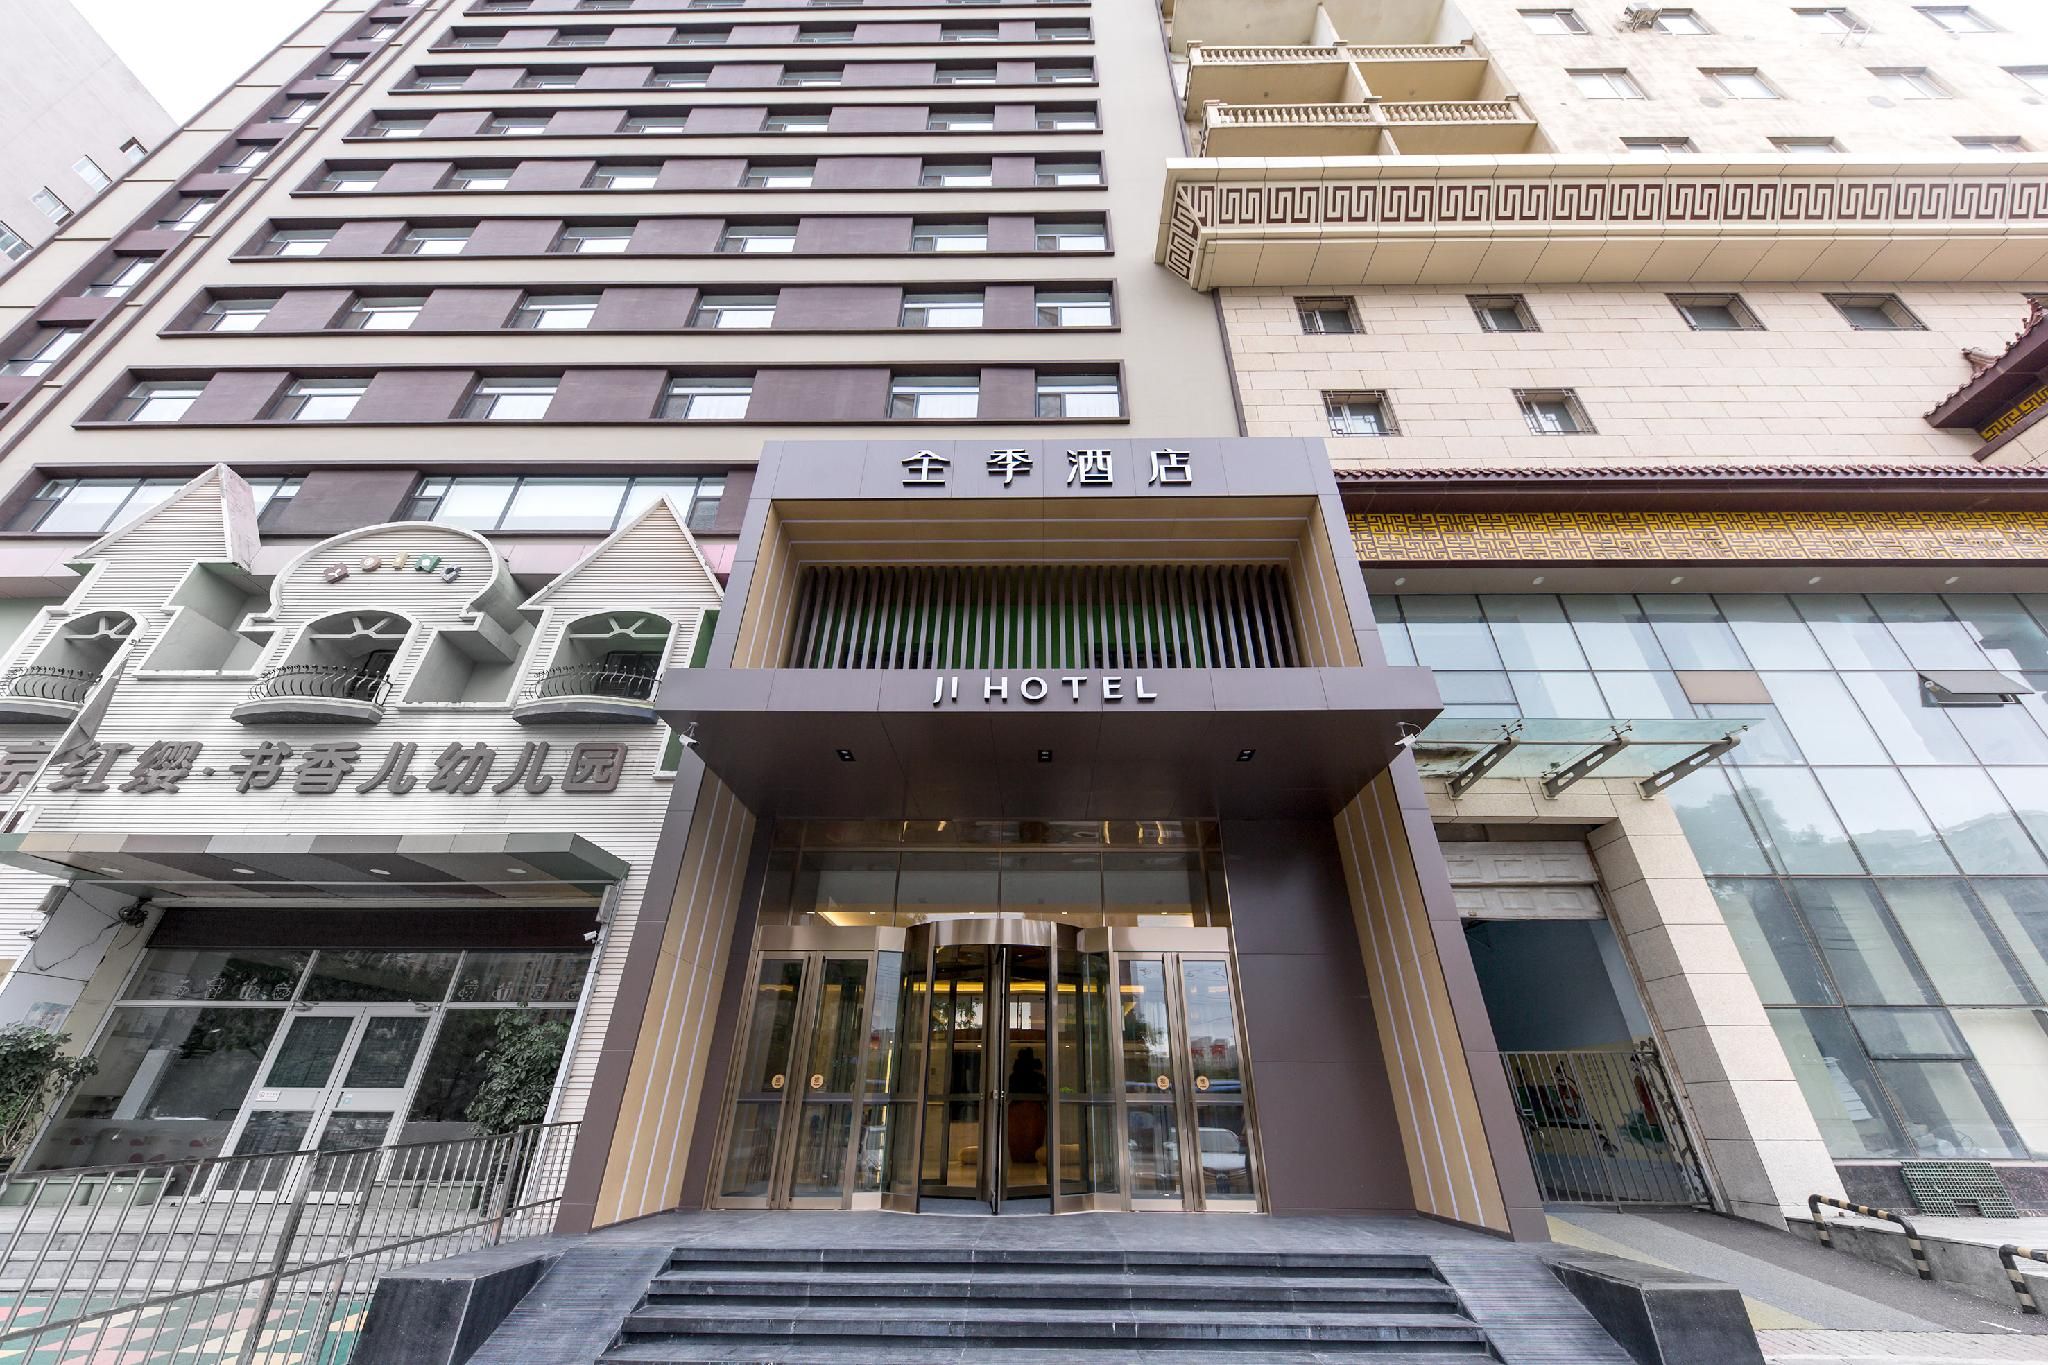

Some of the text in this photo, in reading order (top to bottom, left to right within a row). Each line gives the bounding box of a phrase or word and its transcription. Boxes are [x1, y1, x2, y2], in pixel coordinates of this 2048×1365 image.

[901, 448, 1193, 487] 全季酒店
[933, 676, 1158, 707] JI HOTEL
